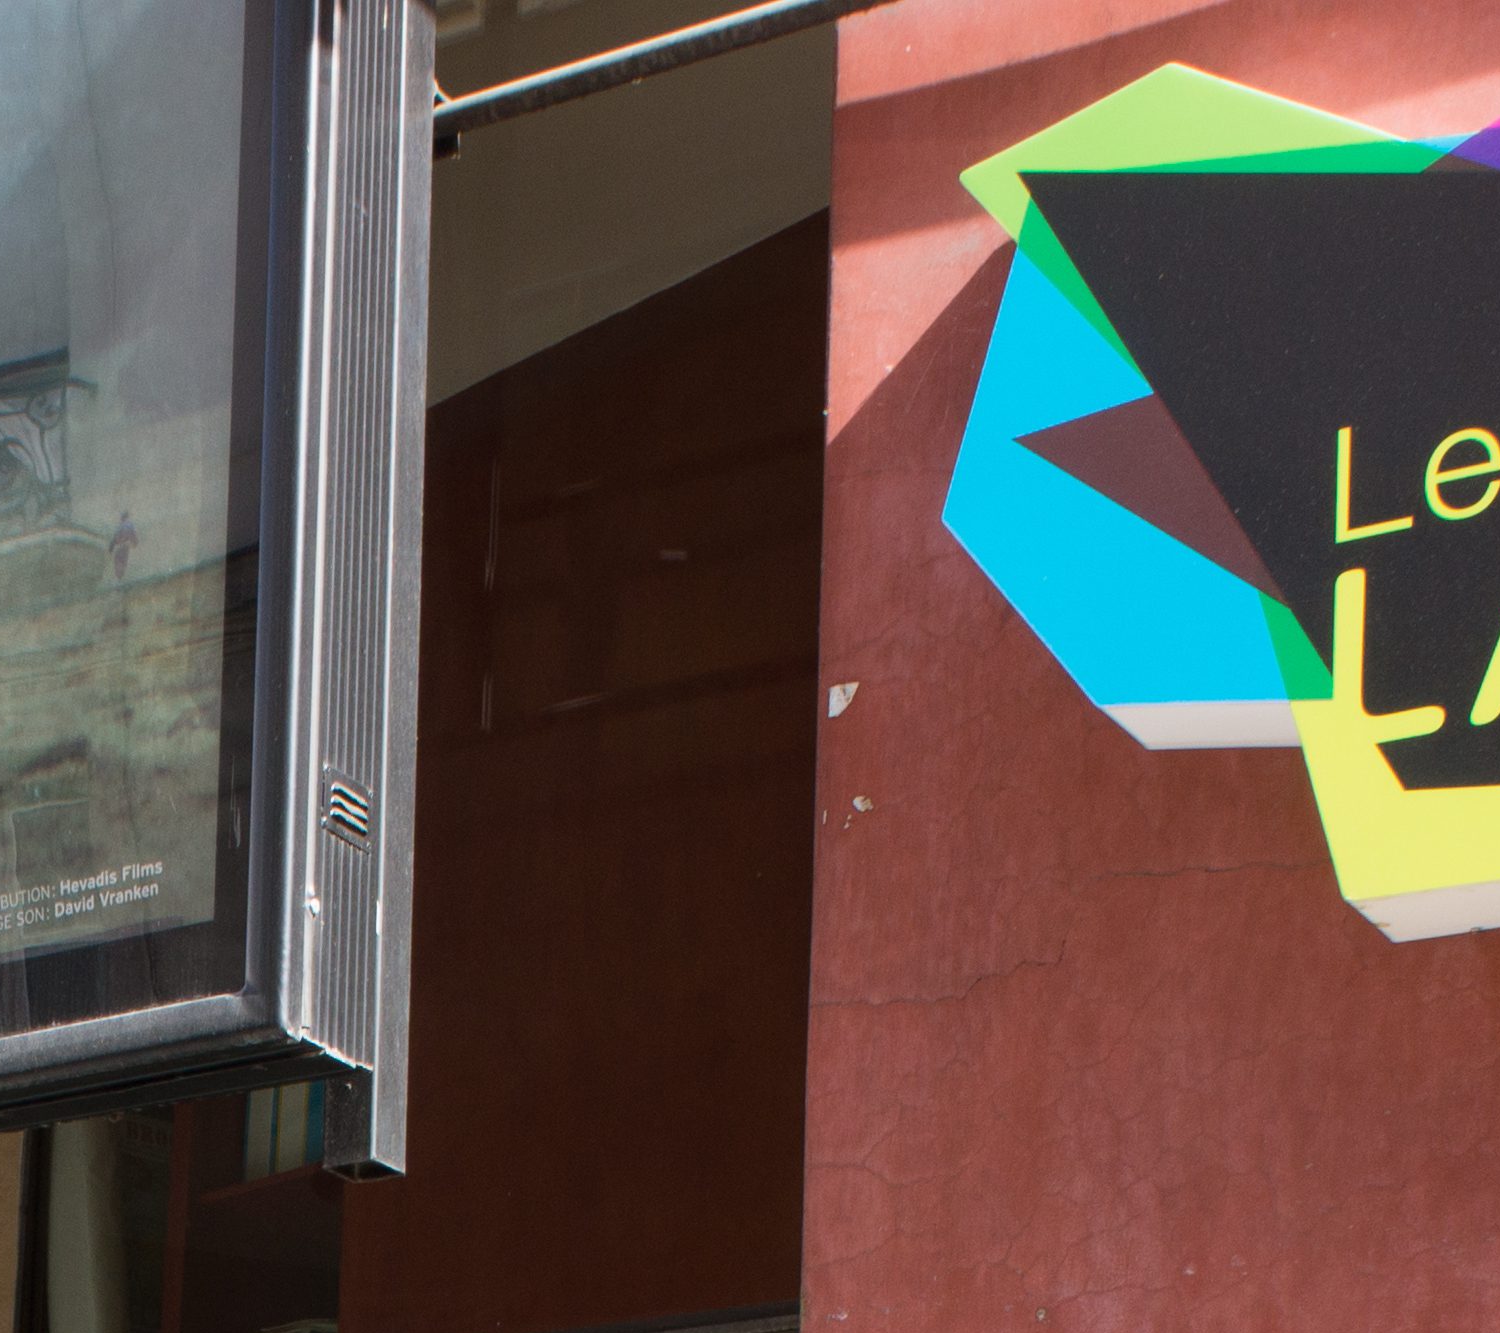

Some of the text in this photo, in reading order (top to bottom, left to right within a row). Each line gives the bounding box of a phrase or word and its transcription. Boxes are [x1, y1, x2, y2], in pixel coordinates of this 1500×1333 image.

[60, 869, 117, 896] Hevadis
[122, 861, 163, 885] Films
[16, 905, 51, 928] SON:
[54, 894, 95, 919] David
[100, 882, 159, 909] Vranken
